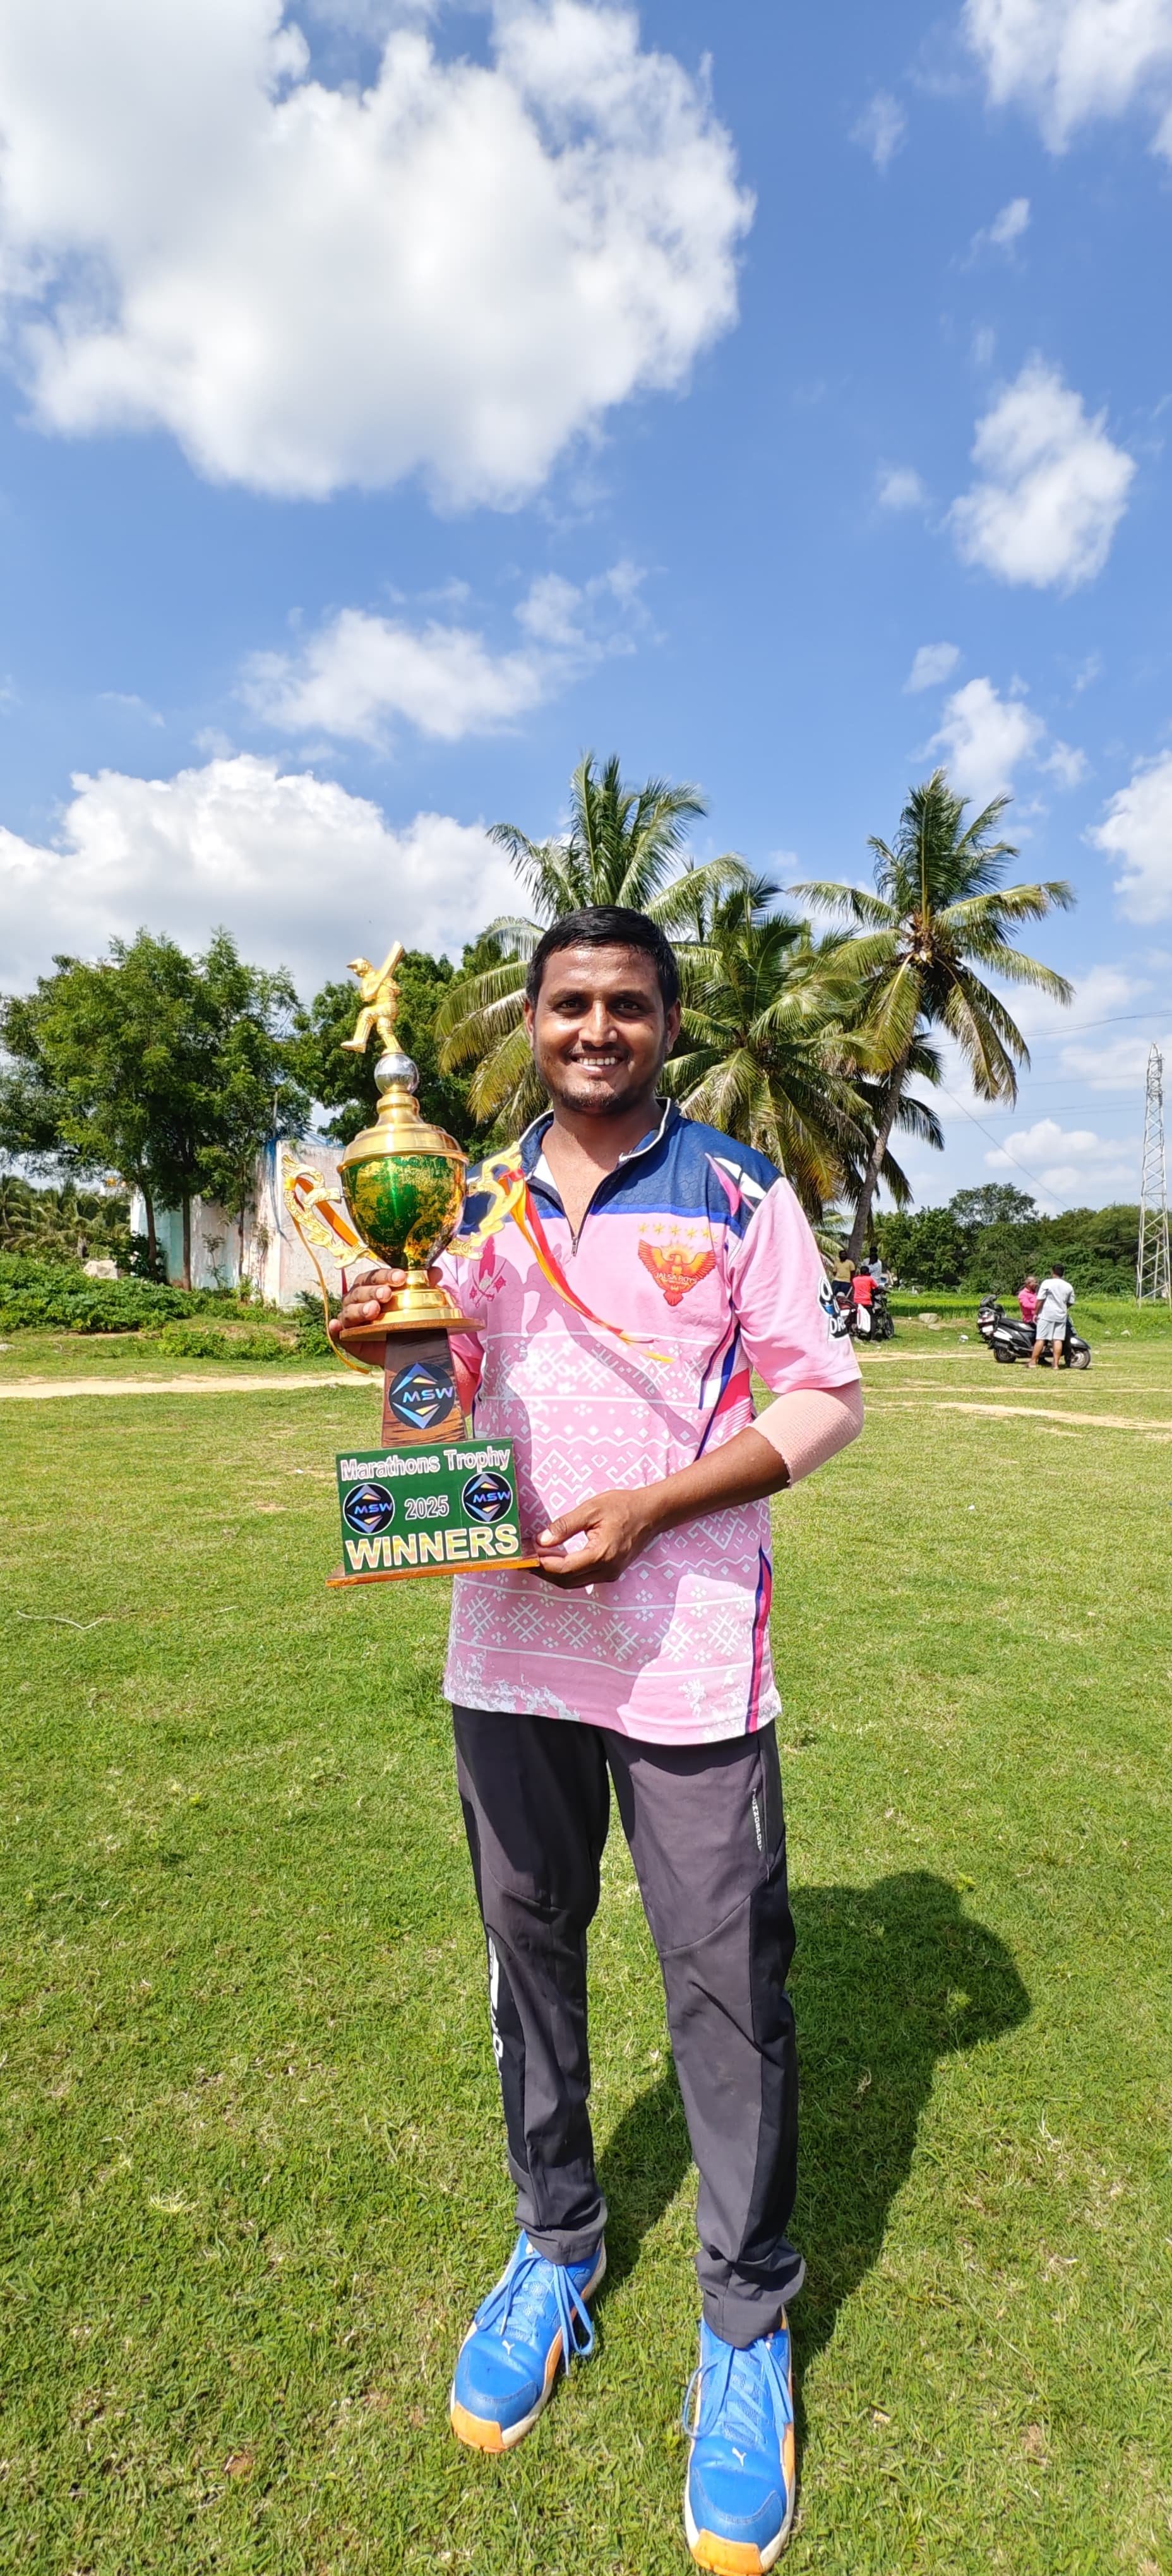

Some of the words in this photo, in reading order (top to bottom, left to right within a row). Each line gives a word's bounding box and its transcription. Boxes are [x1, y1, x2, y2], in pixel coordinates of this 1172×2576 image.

[402, 1385, 454, 1403] MSW
[340, 1455, 441, 1481] Marathons
[443, 1445, 510, 1472] Trophy
[404, 1495, 450, 1520] 2025
[472, 1491, 511, 1503] MSW
[354, 1502, 393, 1515] MSW
[345, 1524, 520, 1571] WINNERS
